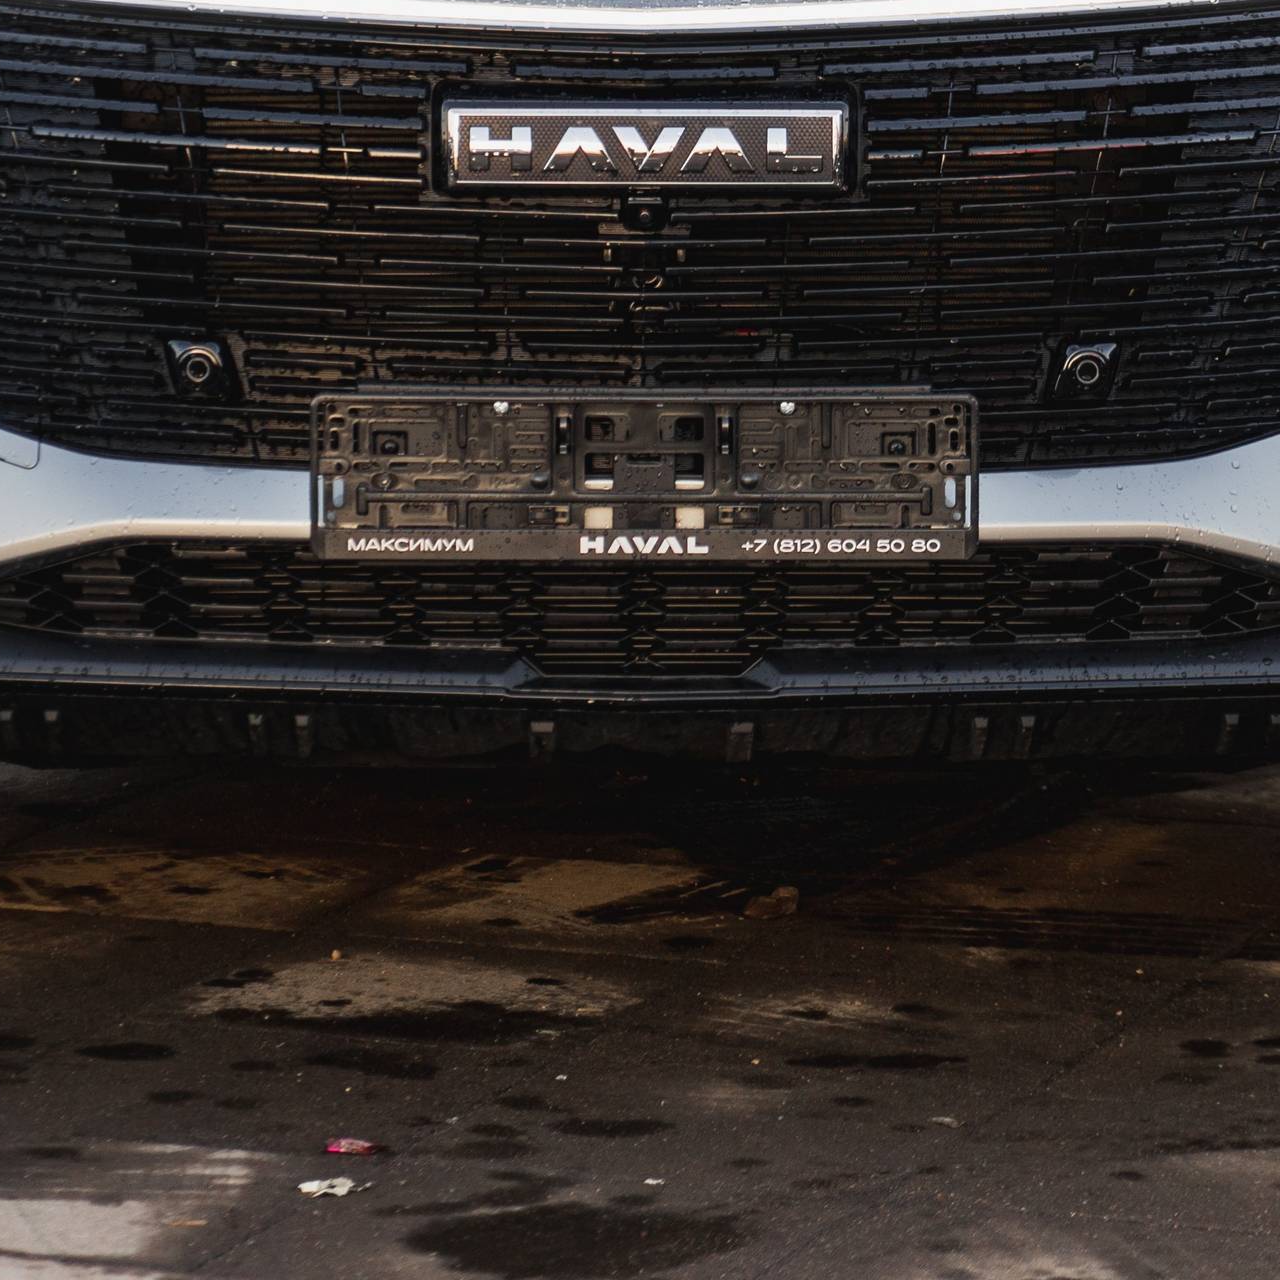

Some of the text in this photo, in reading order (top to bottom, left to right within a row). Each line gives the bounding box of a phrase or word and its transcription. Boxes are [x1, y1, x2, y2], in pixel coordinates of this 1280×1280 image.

[468, 126, 823, 172] HAVAL
[347, 537, 475, 552] МАКСИМУМ
[579, 535, 710, 555] HAVAL
[740, 537, 942, 554] +7 (812) 604 50 80
